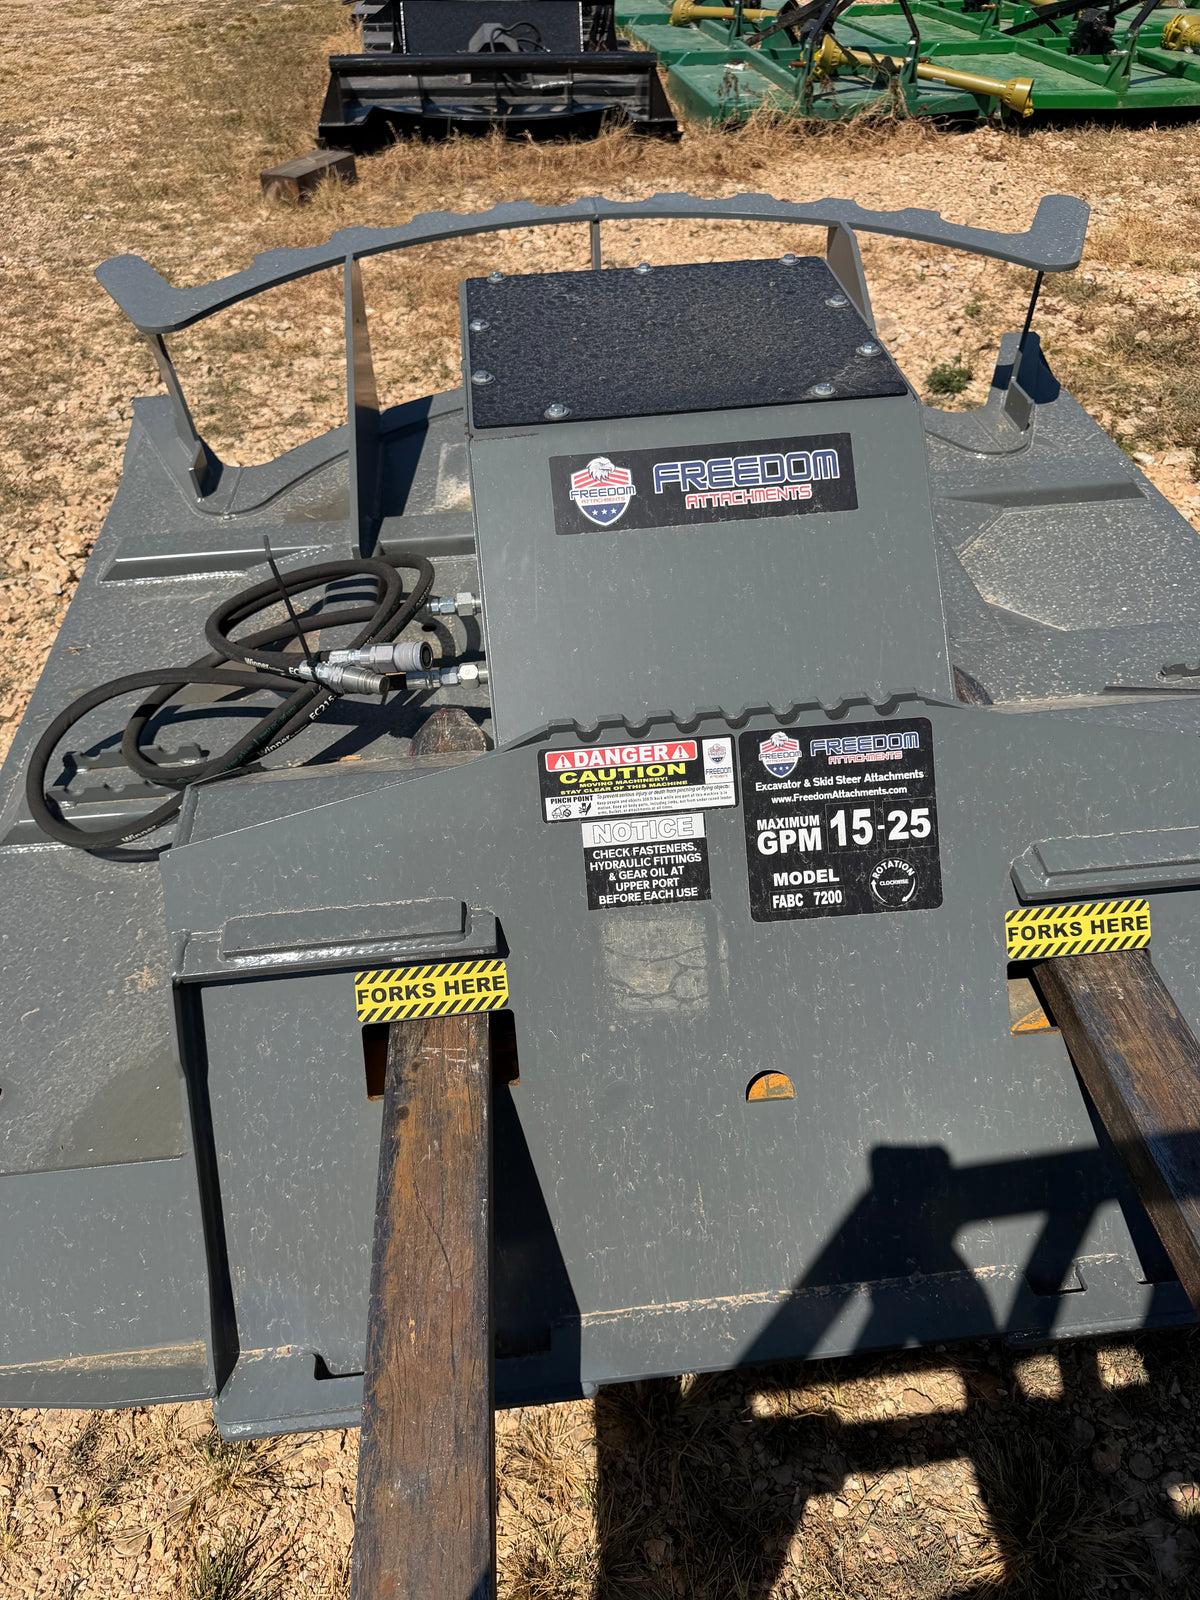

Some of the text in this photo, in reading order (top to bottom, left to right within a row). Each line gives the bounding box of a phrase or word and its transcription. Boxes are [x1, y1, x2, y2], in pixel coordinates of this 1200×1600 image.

[653, 449, 839, 493] FREEDOM
[570, 485, 635, 499] FREEDOM
[580, 495, 625, 504] ATTACHMENTS
[686, 485, 811, 508] ATTACHMENTS
[257, 734, 290, 756] Winner
[809, 731, 919, 755] FREEDOM
[574, 745, 669, 766] DANGER
[759, 750, 802, 760] FREEDOM
[828, 751, 902, 764] ATTACHMENTS
[559, 763, 685, 784] CAUTION
[705, 766, 732, 775] FREEDOM
[578, 776, 668, 788] MOVING MACHINERY!
[755, 769, 923, 791] Excavator & Skid Steer Attachments
[550, 794, 594, 804] PINCH POINT
[771, 785, 907, 803] www.FreedomAttachments.com
[592, 817, 694, 843] NOTICE
[757, 815, 819, 830] MAXIMUM
[121, 824, 156, 842] Winner
[756, 827, 821, 855] GPM
[593, 842, 696, 858] CHECK FASTENERS,
[590, 853, 701, 870] HYDRAULIC FITTINGS
[872, 860, 915, 879] ROTATION
[608, 866, 684, 880] & GEAR OIL AT
[773, 868, 839, 886] MODEL
[615, 878, 679, 890] UPPER PORT
[599, 887, 698, 903] BEFORE EACH USE
[772, 890, 843, 907] FABC 7200
[1007, 915, 1148, 942] FORKS HERE
[357, 975, 506, 1005] FORKS HERE
